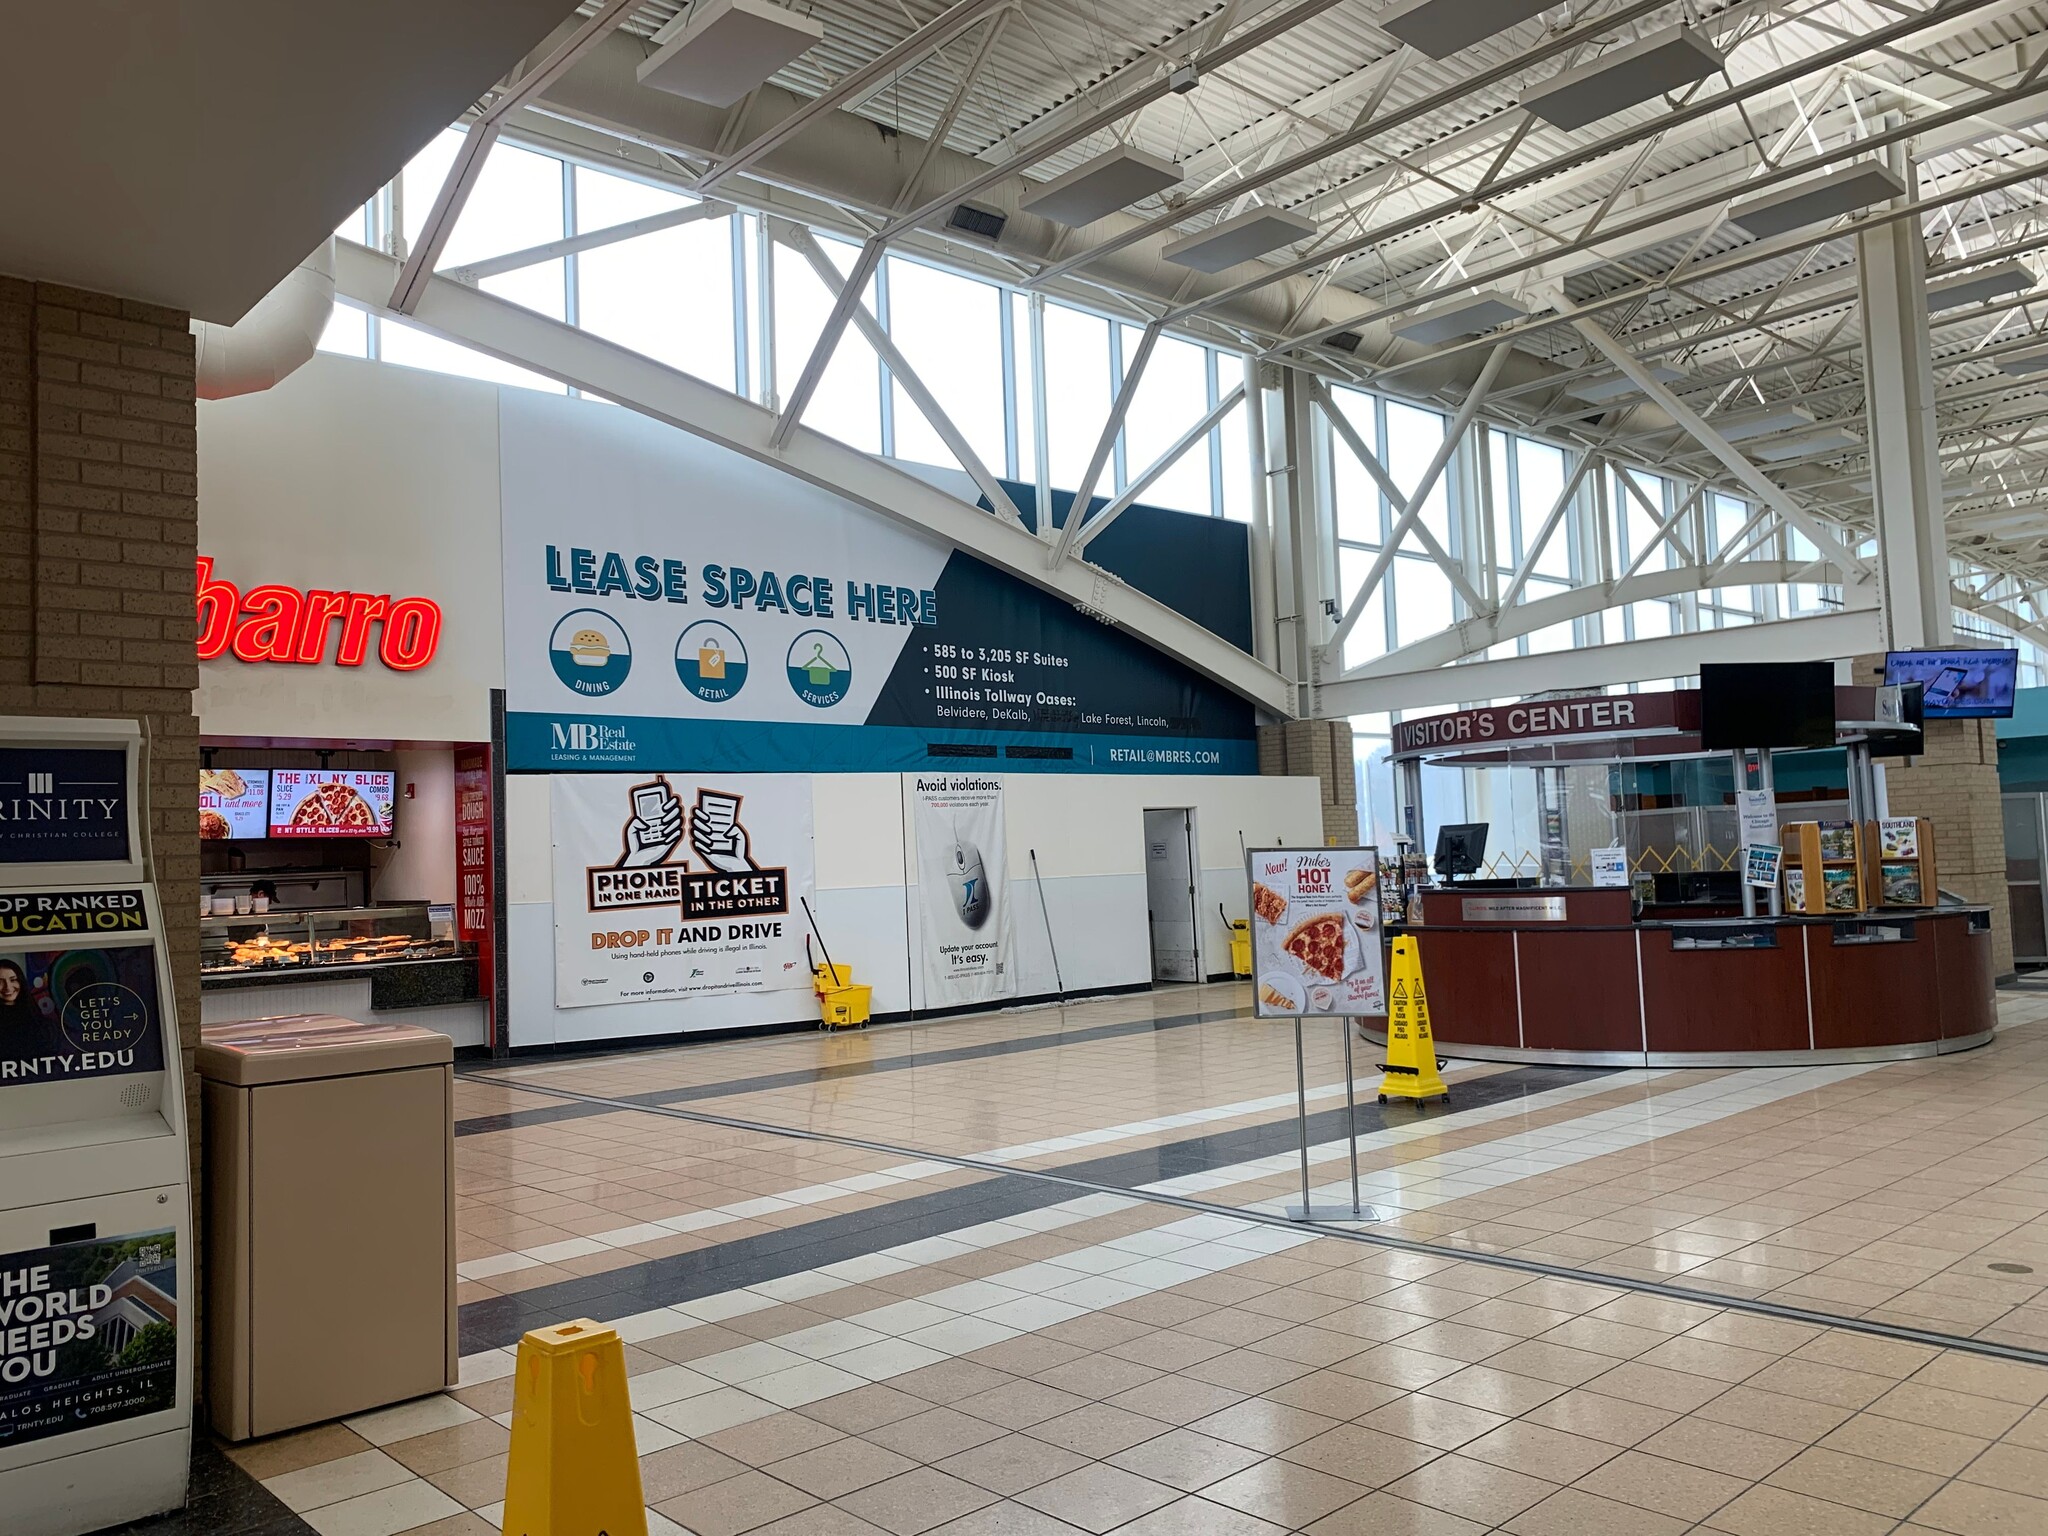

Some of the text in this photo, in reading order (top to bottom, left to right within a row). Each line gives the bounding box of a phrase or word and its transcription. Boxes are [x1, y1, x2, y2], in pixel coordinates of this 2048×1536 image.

[546, 544, 937, 627] LEASE SPACE HERE
[196, 556, 442, 671] barro
[933, 644, 1069, 667] 585 to 3,205 SF Suites
[934, 665, 1015, 683] 500 SF Kiosk
[575, 679, 610, 693] DINING
[698, 686, 729, 699] RETAIL
[802, 689, 839, 704] SERVICES
[935, 686, 1076, 707] Illinois Tollway Oases:
[937, 705, 989, 721] Belvidere,
[992, 708, 1031, 723] DeKalb,
[1081, 712, 1102, 725] Lake
[1105, 714, 1134, 727] Forest,
[1137, 715, 1169, 729] Lincoln,
[1403, 700, 1636, 747] VISITOR'S CENTER
[550, 723, 599, 750] MB
[598, 724, 625, 738] Real
[599, 737, 636, 750] Estate
[589, 754, 636, 762] MANAGEMENT
[1110, 748, 1220, 764] RETAIL@MBRES.COM
[277, 773, 301, 784] THE
[309, 774, 324, 784] XL
[332, 774, 348, 785] NY
[355, 774, 389, 785] SLICE
[916, 776, 1002, 791] Avoid violations.
[247, 788, 264, 796] $11.08
[276, 792, 292, 801] $5.29
[369, 785, 389, 793] COMBO
[200, 796, 263, 808] OLI and more
[462, 801, 484, 820] DOUGH
[366, 825, 379, 833] $9.99
[1882, 820, 1915, 829] SOUTHLAND
[462, 848, 484, 866] SAUCE
[1296, 853, 1331, 868] Mike's
[1264, 858, 1288, 876] New!
[597, 870, 679, 892] PHONE
[1296, 868, 1331, 884] HOT
[463, 874, 485, 895] 100%
[689, 876, 779, 899] TICKET
[37, 895, 138, 911] RANKED
[598, 887, 680, 903] IN ONE HAND
[690, 897, 780, 912] IN THE OTHER
[966, 904, 979, 913] PASS
[0, 911, 142, 933] UCATION
[464, 908, 485, 929] MOZZ
[591, 923, 782, 950] DROP IT AND DRIVE
[629, 950, 659, 959] hand-held
[660, 950, 682, 958] phones
[697, 946, 718, 955] driving
[724, 945, 741, 953] illegal
[748, 943, 768, 951] Illinois.
[939, 944, 960, 955] Update
[961, 944, 974, 953] your
[951, 953, 989, 965] It's easy.
[645, 987, 677, 995] information,
[79, 996, 121, 1009] LET'S
[80, 1008, 110, 1020] GET
[80, 1019, 113, 1031] YOU
[82, 1029, 132, 1042] READY
[2, 1049, 134, 1079] RNTY.EDU
[0, 1264, 50, 1298] HE
[0, 1314, 95, 1356] EEDS
[0, 1349, 56, 1383] OU
[43, 1379, 80, 1392] GRADUATE
[91, 1372, 113, 1382] ADULT
[114, 1359, 171, 1377] UNDERGRADUATE
[0, 1379, 154, 1420] ALOS HEIGHTS, IL
[17, 1396, 146, 1431] TRNTY.EDU 708.597.3000
